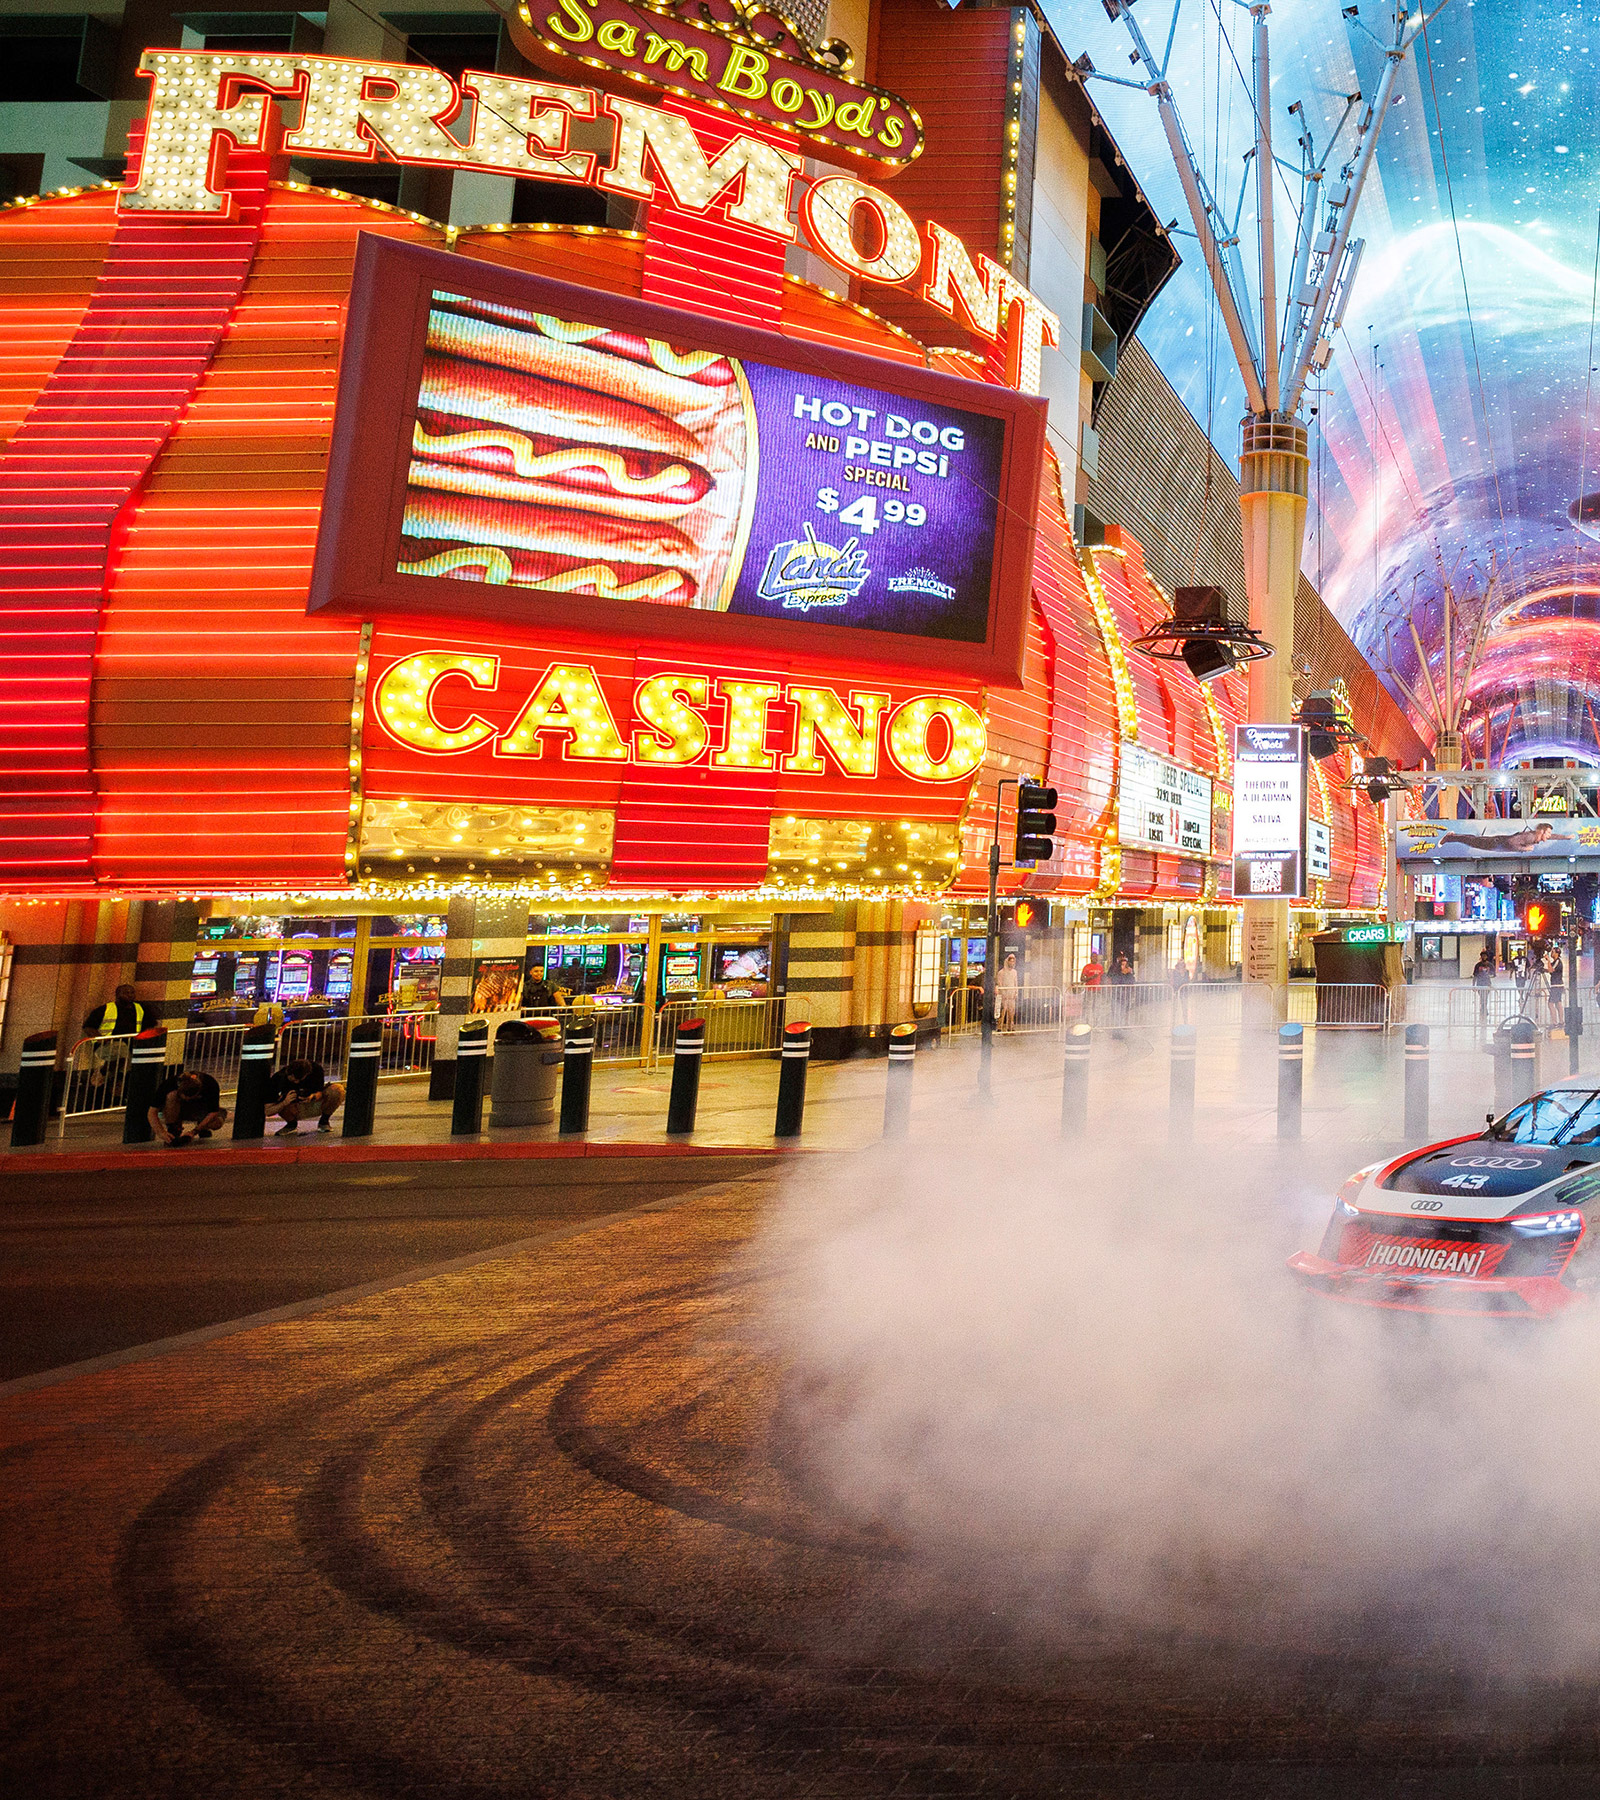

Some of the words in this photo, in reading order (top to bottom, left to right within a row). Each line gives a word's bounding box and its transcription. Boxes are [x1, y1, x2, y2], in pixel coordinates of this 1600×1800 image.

[546, 0, 711, 82] Sam
[716, 42, 904, 148] Boyd's
[115, 49, 1058, 393] FREMONT
[793, 393, 876, 432] HOT
[885, 413, 965, 451] DOG
[805, 433, 839, 453] AND
[845, 436, 948, 477] PEPSI
[843, 465, 910, 491] SPECIAL
[757, 538, 870, 597] Lanai
[888, 576, 956, 600] FREMONT
[785, 592, 847, 610] Express
[374, 651, 987, 783] CASINO
[1246, 728, 1290, 740] Downtown
[1246, 780, 1276, 789] THEORY
[1243, 793, 1248, 802] A
[1251, 793, 1291, 802] DEADMAN
[1253, 815, 1282, 824] SALIVA
[1349, 928, 1385, 942] CIGARS
[1441, 1174, 1490, 1189] 43
